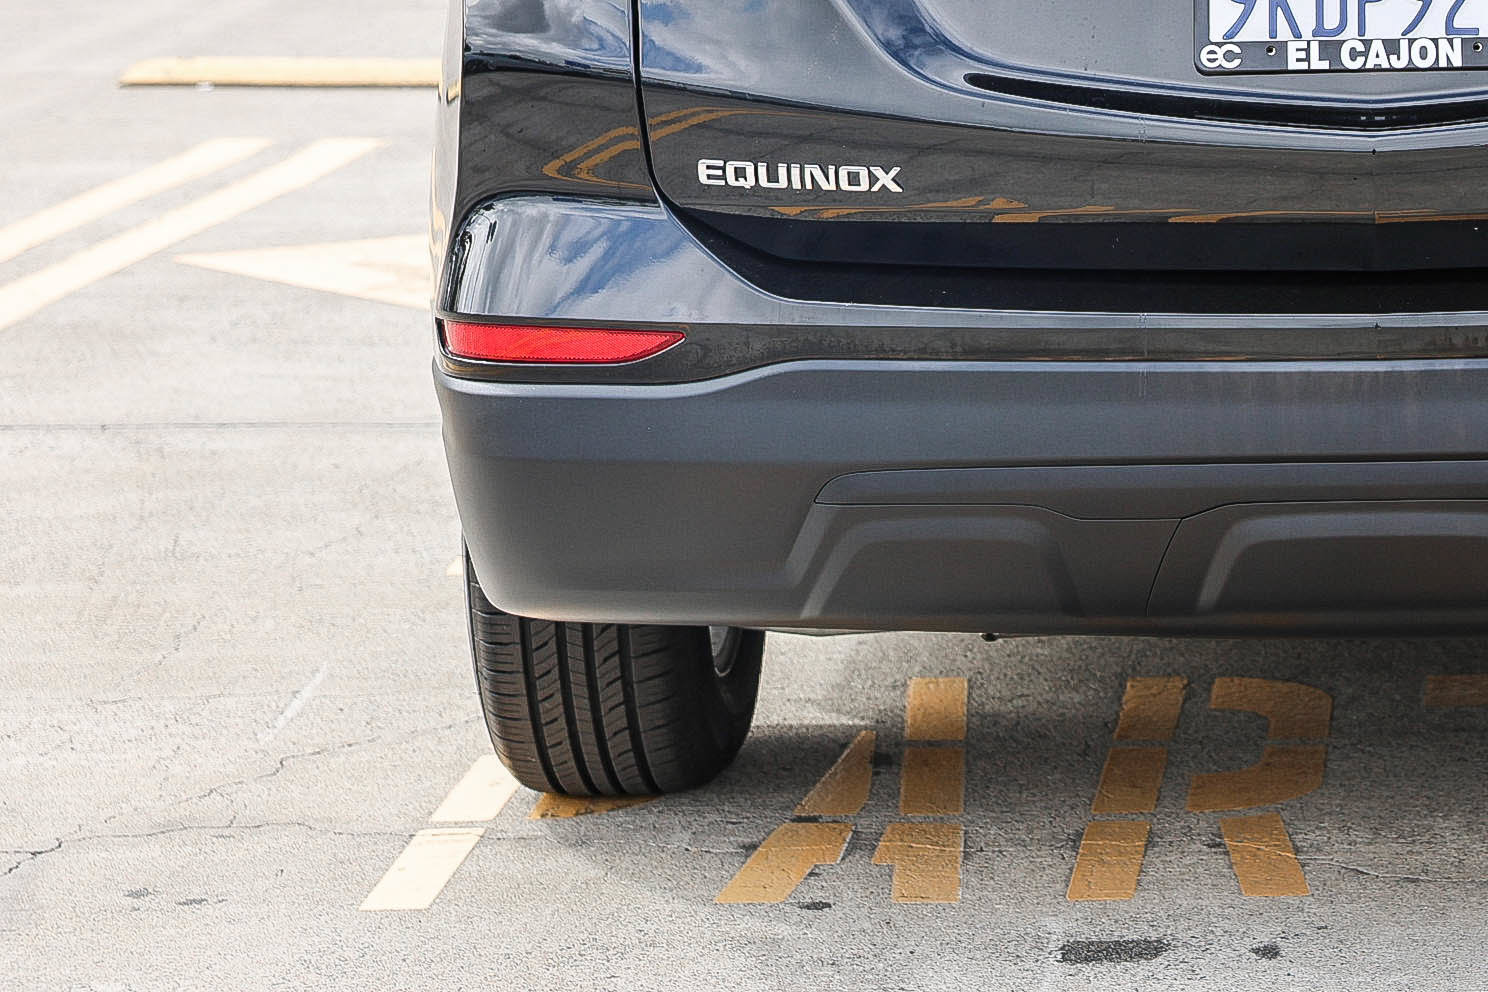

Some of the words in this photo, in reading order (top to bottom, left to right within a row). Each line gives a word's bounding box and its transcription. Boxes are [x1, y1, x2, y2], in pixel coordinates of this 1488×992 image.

[1287, 39, 1330, 70] EL
[1340, 37, 1463, 69] CAJON
[697, 158, 904, 193] EQUINOX
